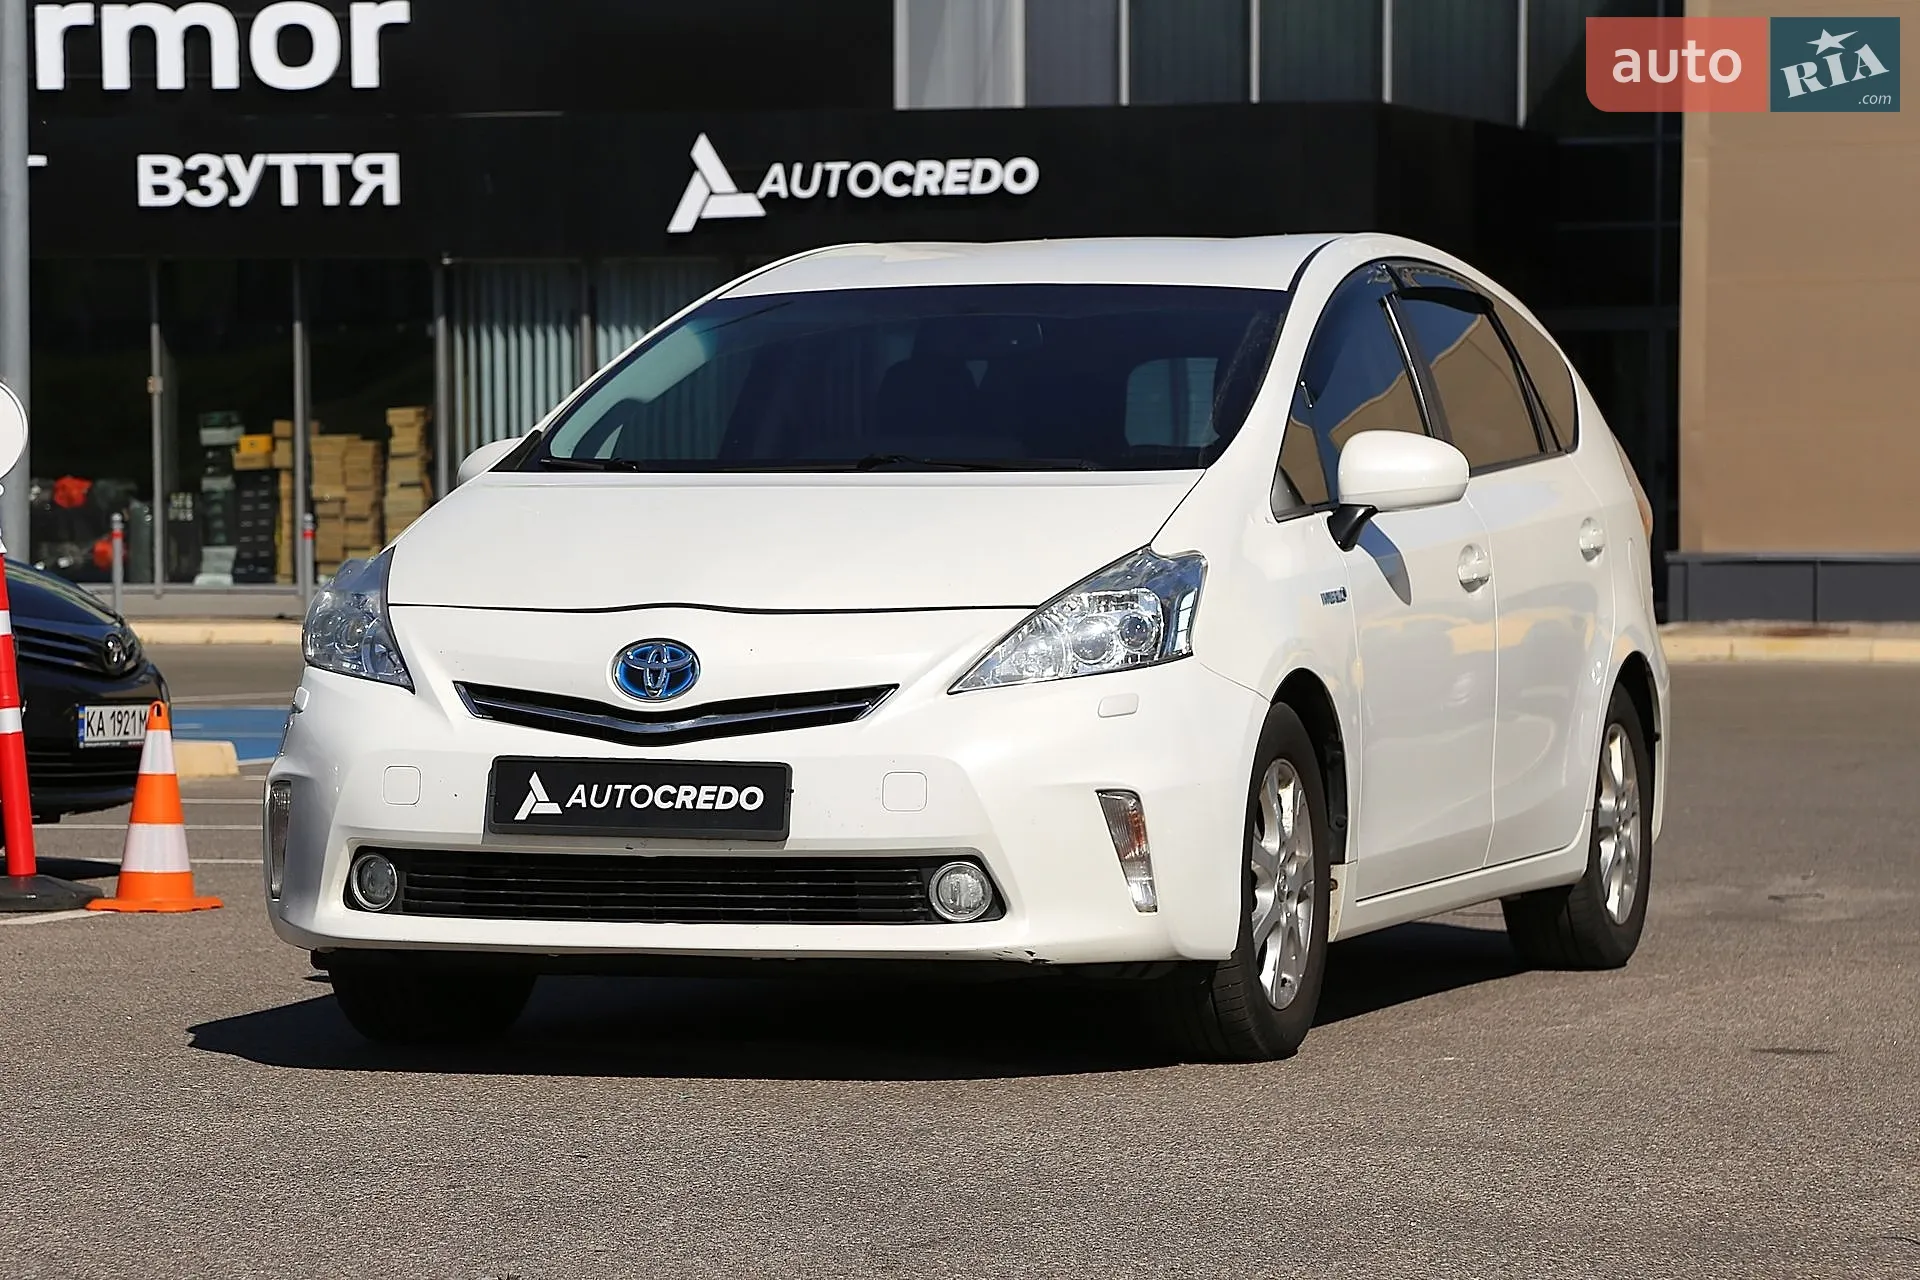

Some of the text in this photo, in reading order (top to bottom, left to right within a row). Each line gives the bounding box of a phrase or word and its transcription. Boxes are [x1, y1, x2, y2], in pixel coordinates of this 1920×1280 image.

[34, 0, 411, 91] rmor
[137, 153, 401, 207] ВЗУТТЯ
[757, 157, 1040, 199] AUTOCREDO
[86, 711, 105, 737] KA
[110, 710, 136, 736] 1921
[565, 784, 764, 811] AUTOCREDO
